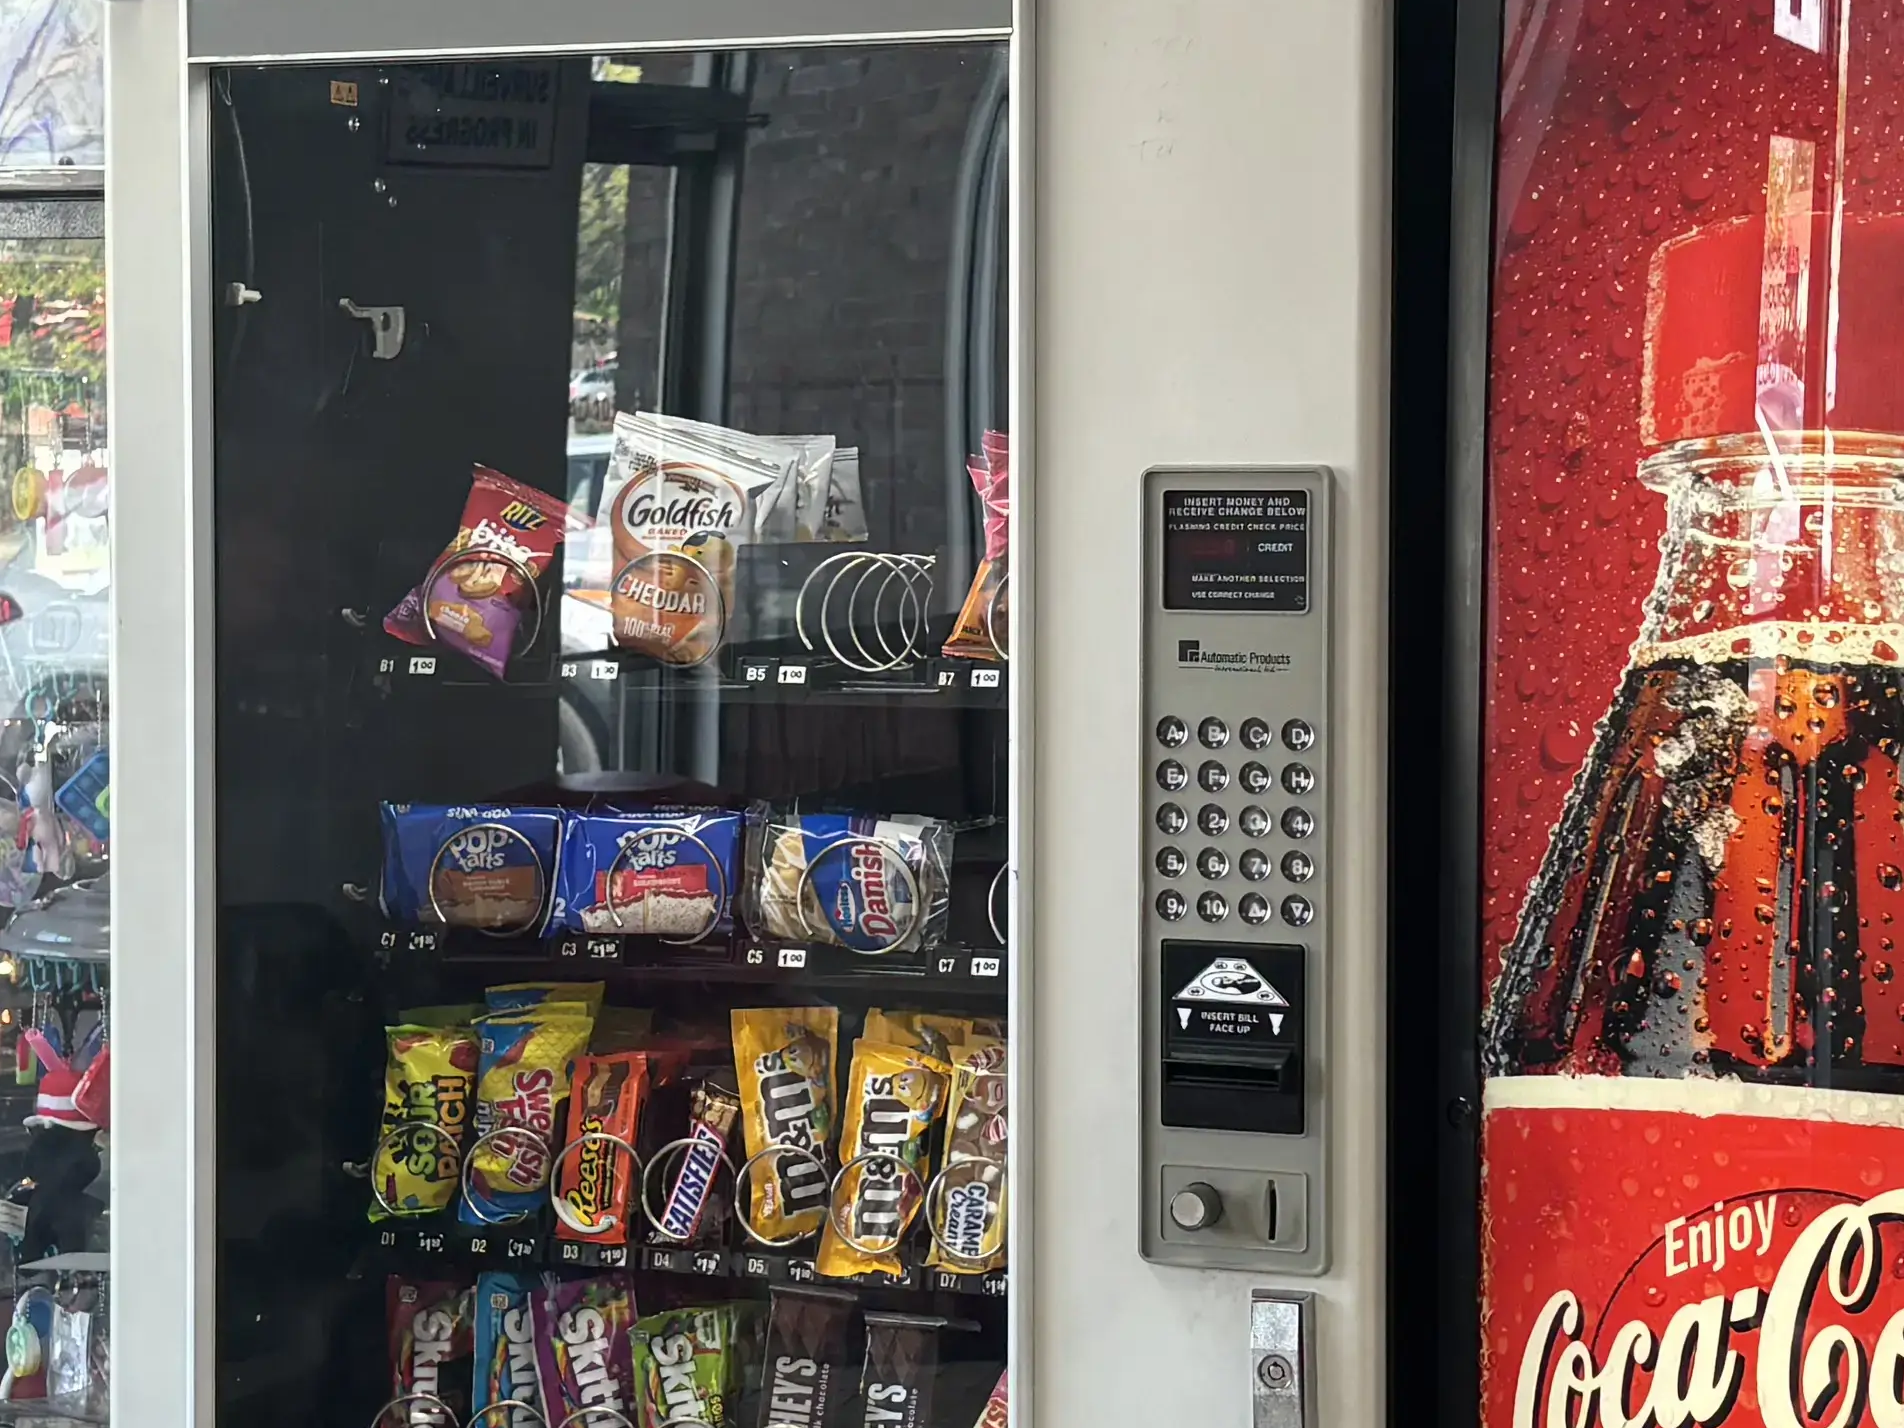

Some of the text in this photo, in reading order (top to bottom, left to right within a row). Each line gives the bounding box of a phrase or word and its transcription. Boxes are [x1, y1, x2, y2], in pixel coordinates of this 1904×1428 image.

[1184, 497, 1291, 507] INSERT MONEY AND
[500, 501, 547, 530] RITZ
[628, 494, 732, 529] Goldfish
[1169, 507, 1305, 516] RECEIVE CHANGE BELOW
[1257, 543, 1294, 552] CREDIT
[617, 574, 706, 614] CHEDDAR
[380, 659, 394, 672] B1
[1200, 652, 1291, 665] Automatic Products
[747, 667, 766, 681] B5
[938, 673, 954, 685] B7
[1167, 728, 1303, 744] A B C D
[1249, 771, 1262, 786] G
[1291, 772, 1304, 787] H
[1169, 812, 1303, 830] 1 2 3 4
[1208, 856, 1219, 871] 6
[1250, 858, 1260, 872] 7
[1292, 860, 1302, 875] 8
[1167, 899, 1221, 915] 9 10
[747, 949, 763, 963] C5
[938, 959, 955, 973] C7
[1201, 1011, 1259, 1023] INSERT BILL
[1209, 1023, 1250, 1034] FACE UP
[1664, 1196, 1778, 1277] Enjoy
[471, 1239, 487, 1253] D2
[563, 1244, 579, 1259] D3
[654, 1253, 669, 1267] D4
[748, 1258, 764, 1272] D5
[940, 1274, 957, 1288] D7
[817, 1363, 830, 1416] chocolate
